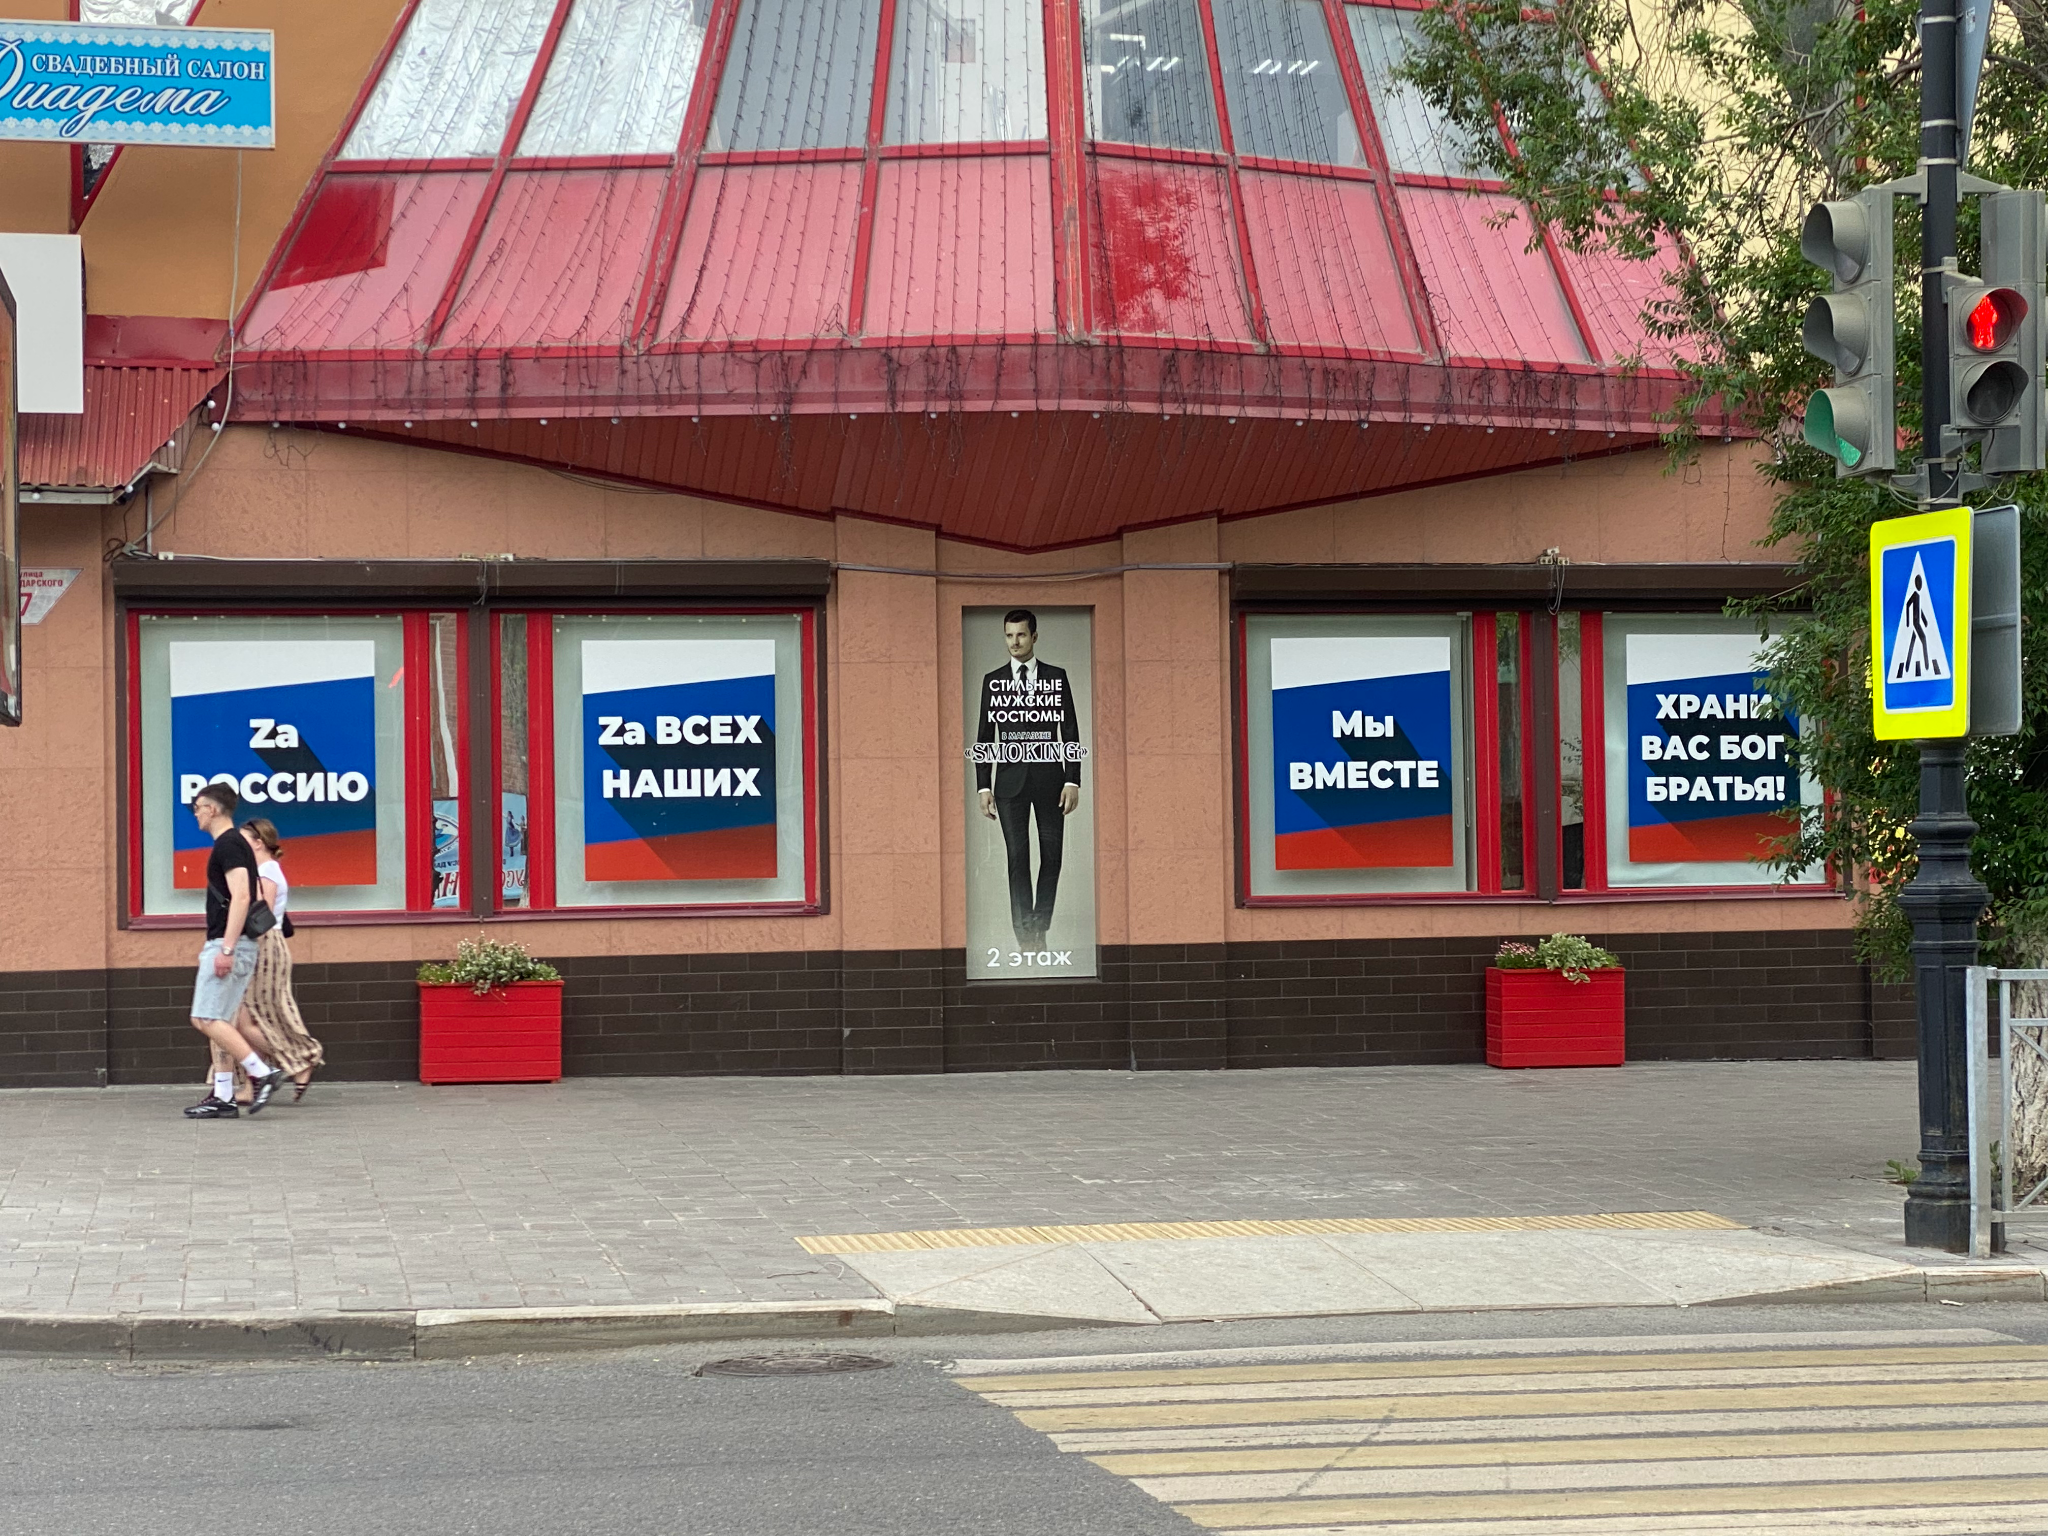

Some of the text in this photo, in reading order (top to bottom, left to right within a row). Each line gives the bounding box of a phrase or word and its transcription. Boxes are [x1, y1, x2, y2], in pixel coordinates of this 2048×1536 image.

[31, 53, 266, 80] СВАДЕБНЫЙ САЛОН
[20, 579, 63, 587] ДАРСКОГО
[989, 679, 1063, 691] СТИЛЬНЫЕ
[990, 694, 1062, 707] МУЖСКИЕ
[987, 709, 1065, 723] КОСТЮМЫ
[1332, 710, 1394, 738] Мы
[249, 718, 299, 749] Za
[598, 715, 763, 746] Za ВСЕХ
[1001, 731, 1052, 740] В МАГАЗИНЕ
[964, 741, 1089, 763] «SMOKING»
[1641, 734, 1790, 763] ВАС БОГ,
[602, 767, 761, 798] НАШИХ
[1289, 760, 1440, 789] ВМЕСТЕ
[1646, 775, 1786, 802] БРАТЬЯ!
[986, 947, 1073, 967] 2 этаж
